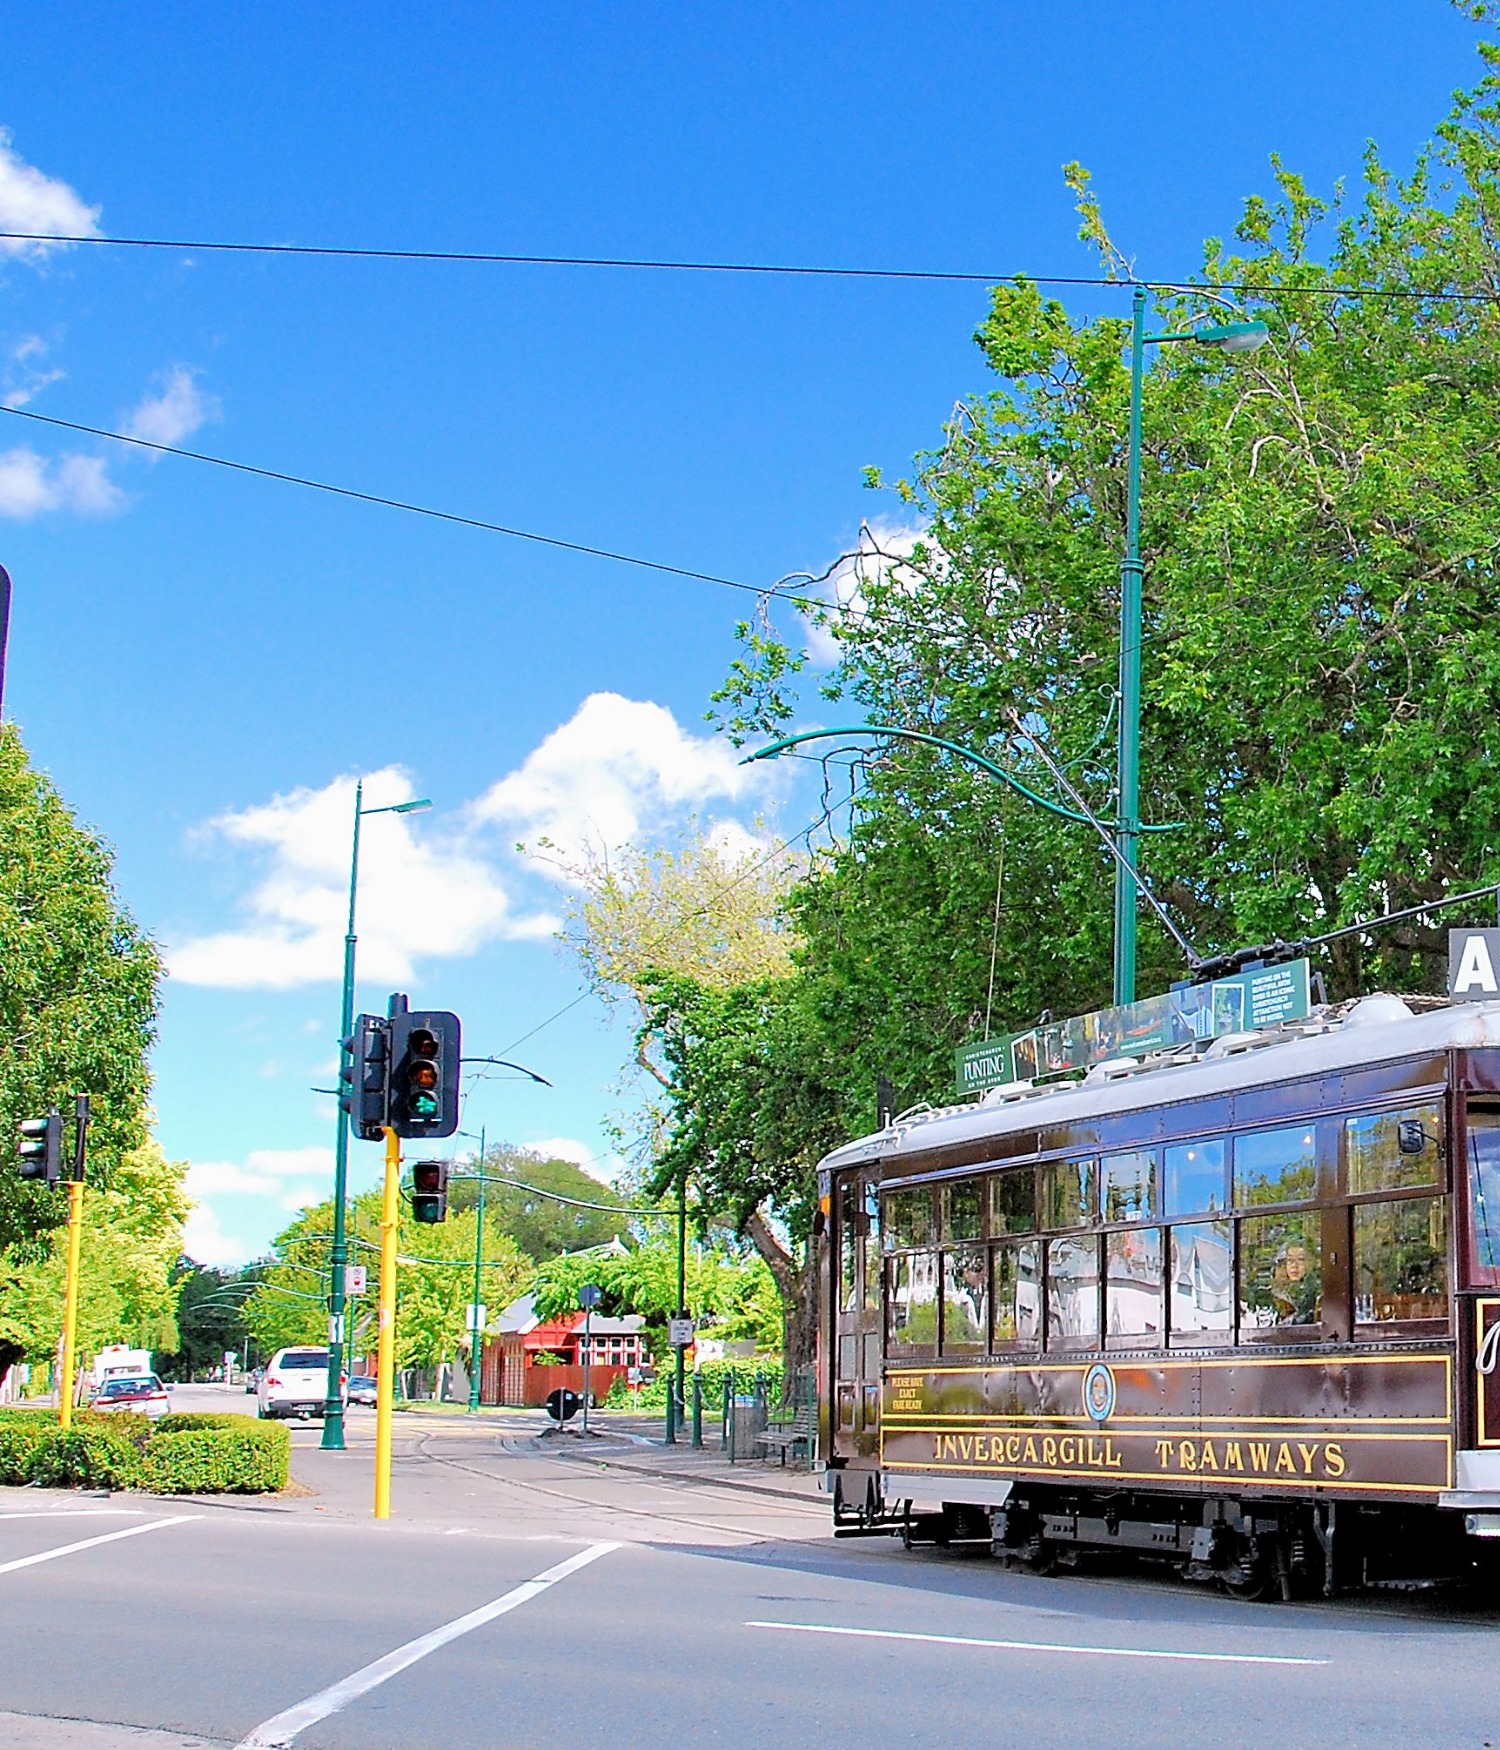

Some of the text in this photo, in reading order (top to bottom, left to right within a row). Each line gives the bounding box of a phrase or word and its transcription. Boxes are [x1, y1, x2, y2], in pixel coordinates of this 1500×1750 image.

[1453, 935, 1498, 993] A
[964, 1054, 1005, 1081] PUNTING
[935, 1435, 1346, 1477] INVERCARGILL TRAMWAYS
